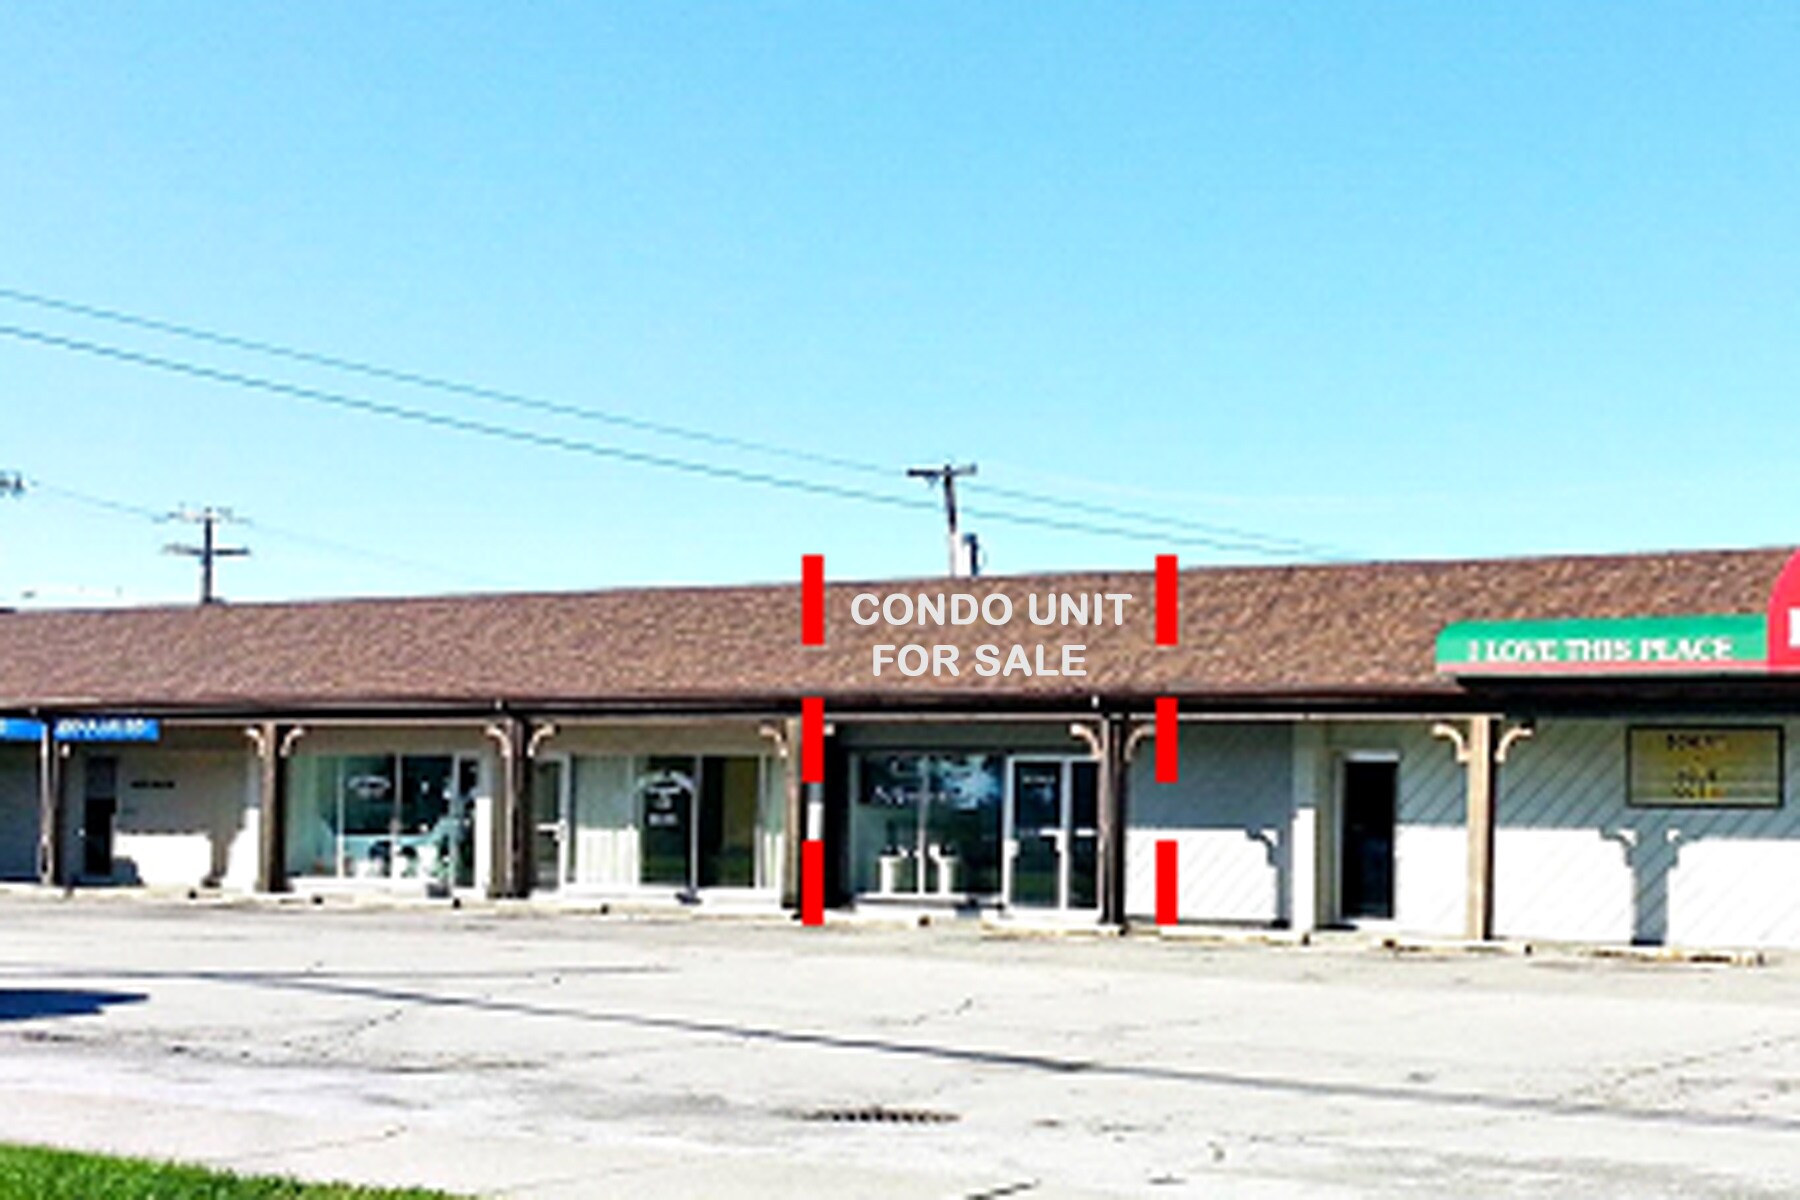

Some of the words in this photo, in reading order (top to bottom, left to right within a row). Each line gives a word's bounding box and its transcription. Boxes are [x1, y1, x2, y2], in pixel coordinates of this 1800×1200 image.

[1485, 640, 1558, 662] LOVE
[1563, 639, 1632, 662] THIS
[1638, 636, 1734, 662] PLACE
